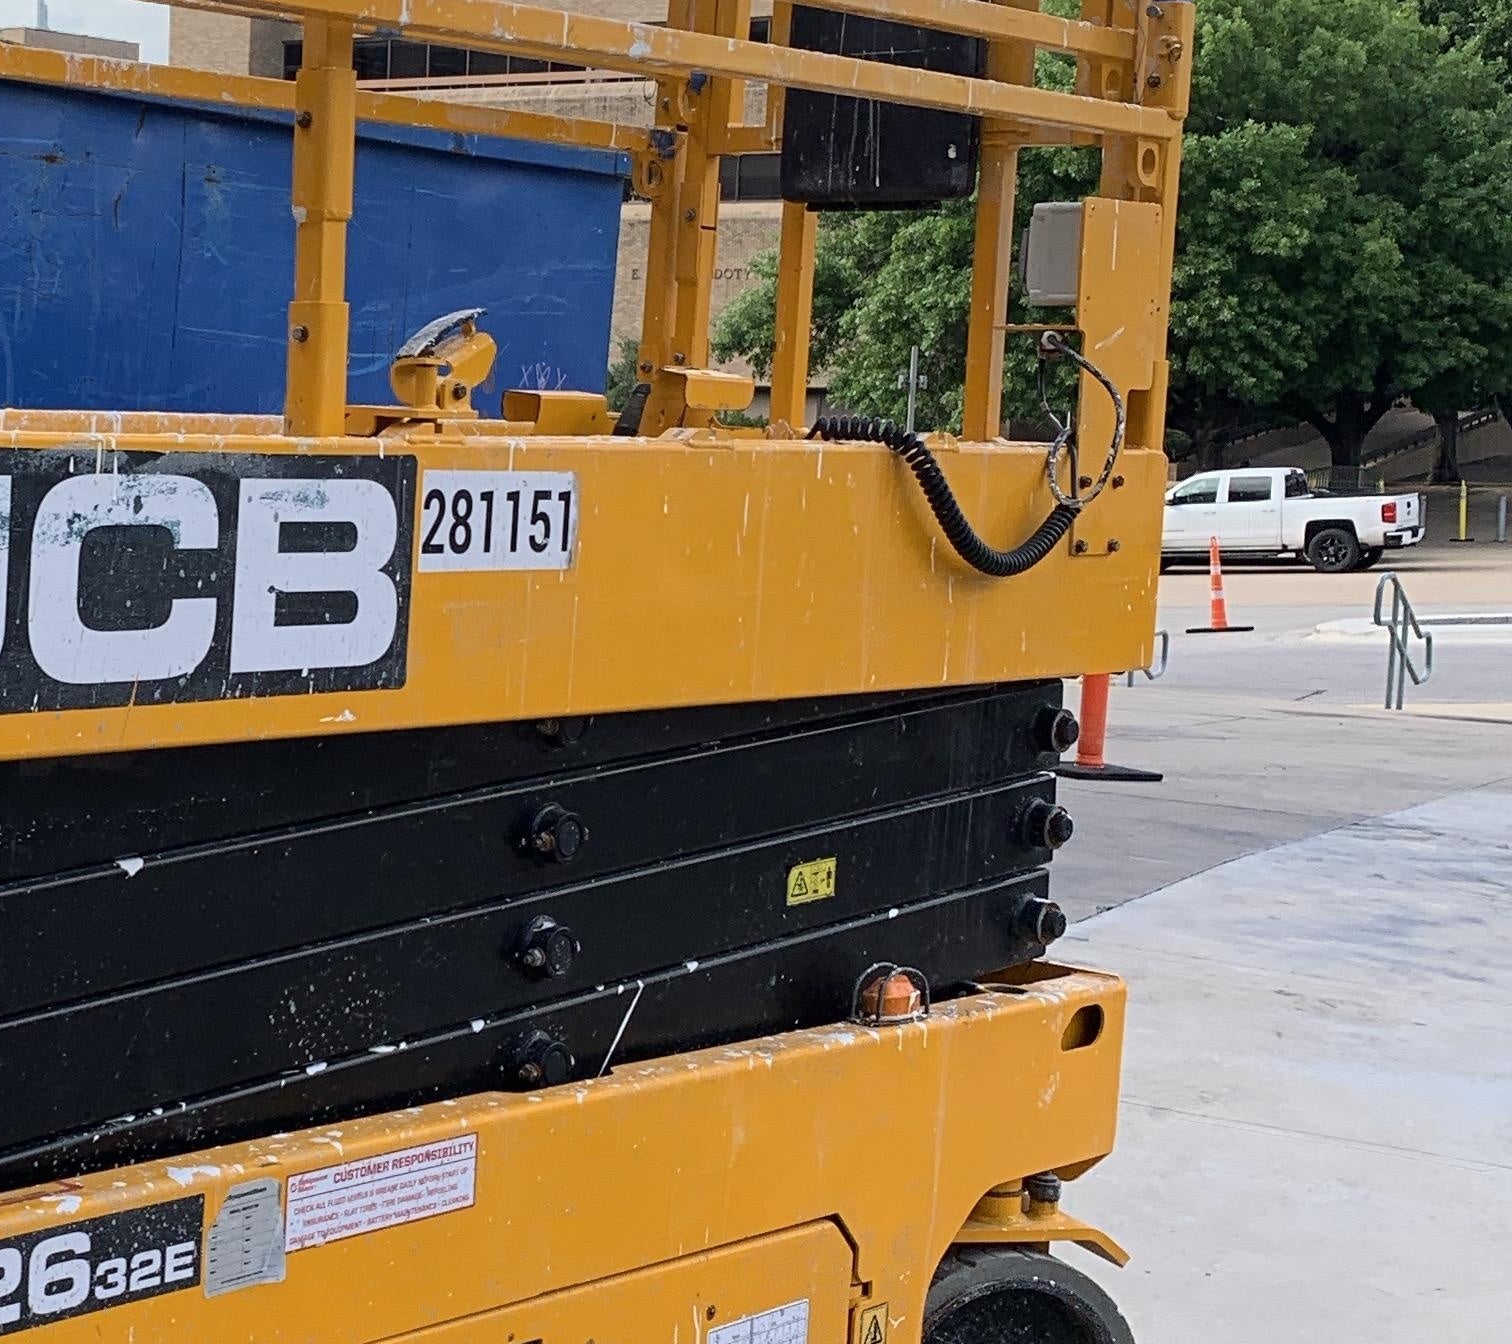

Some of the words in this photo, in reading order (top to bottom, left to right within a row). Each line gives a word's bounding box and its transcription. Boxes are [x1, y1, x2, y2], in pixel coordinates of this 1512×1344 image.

[714, 268, 752, 280] DOTY
[422, 489, 571, 555] 281151
[333, 1159, 390, 1184] CUSTOMER
[392, 1141, 474, 1171] RESPONSIBILITY
